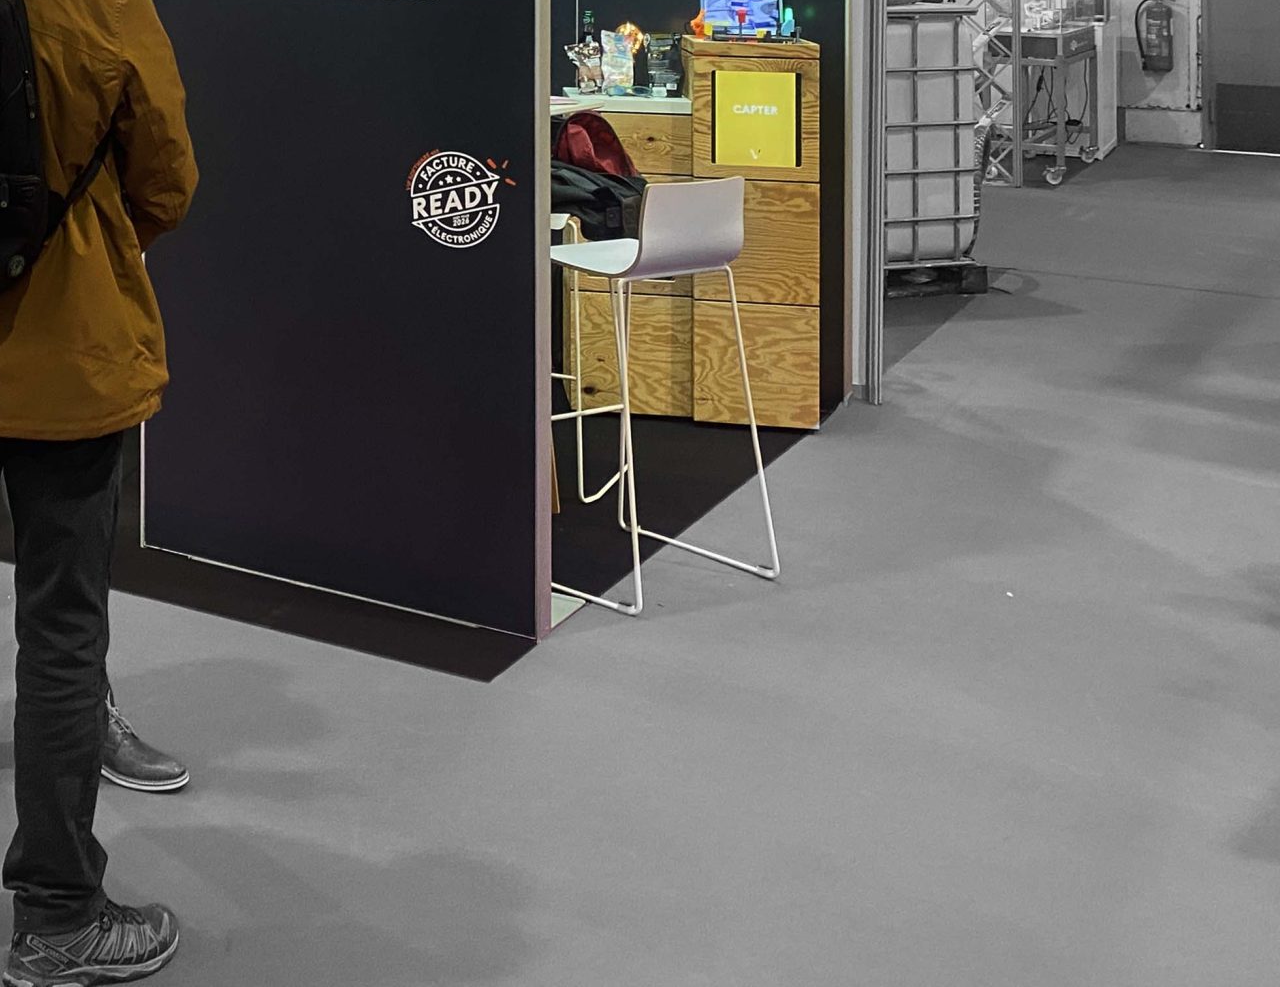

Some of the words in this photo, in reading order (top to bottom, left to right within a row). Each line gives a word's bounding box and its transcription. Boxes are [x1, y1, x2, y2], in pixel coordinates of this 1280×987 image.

[732, 104, 779, 115] CAPTER
[420, 156, 476, 181] FACTURE
[412, 181, 499, 220] READY
[431, 216, 492, 243] ÉLECTRONIQUE
